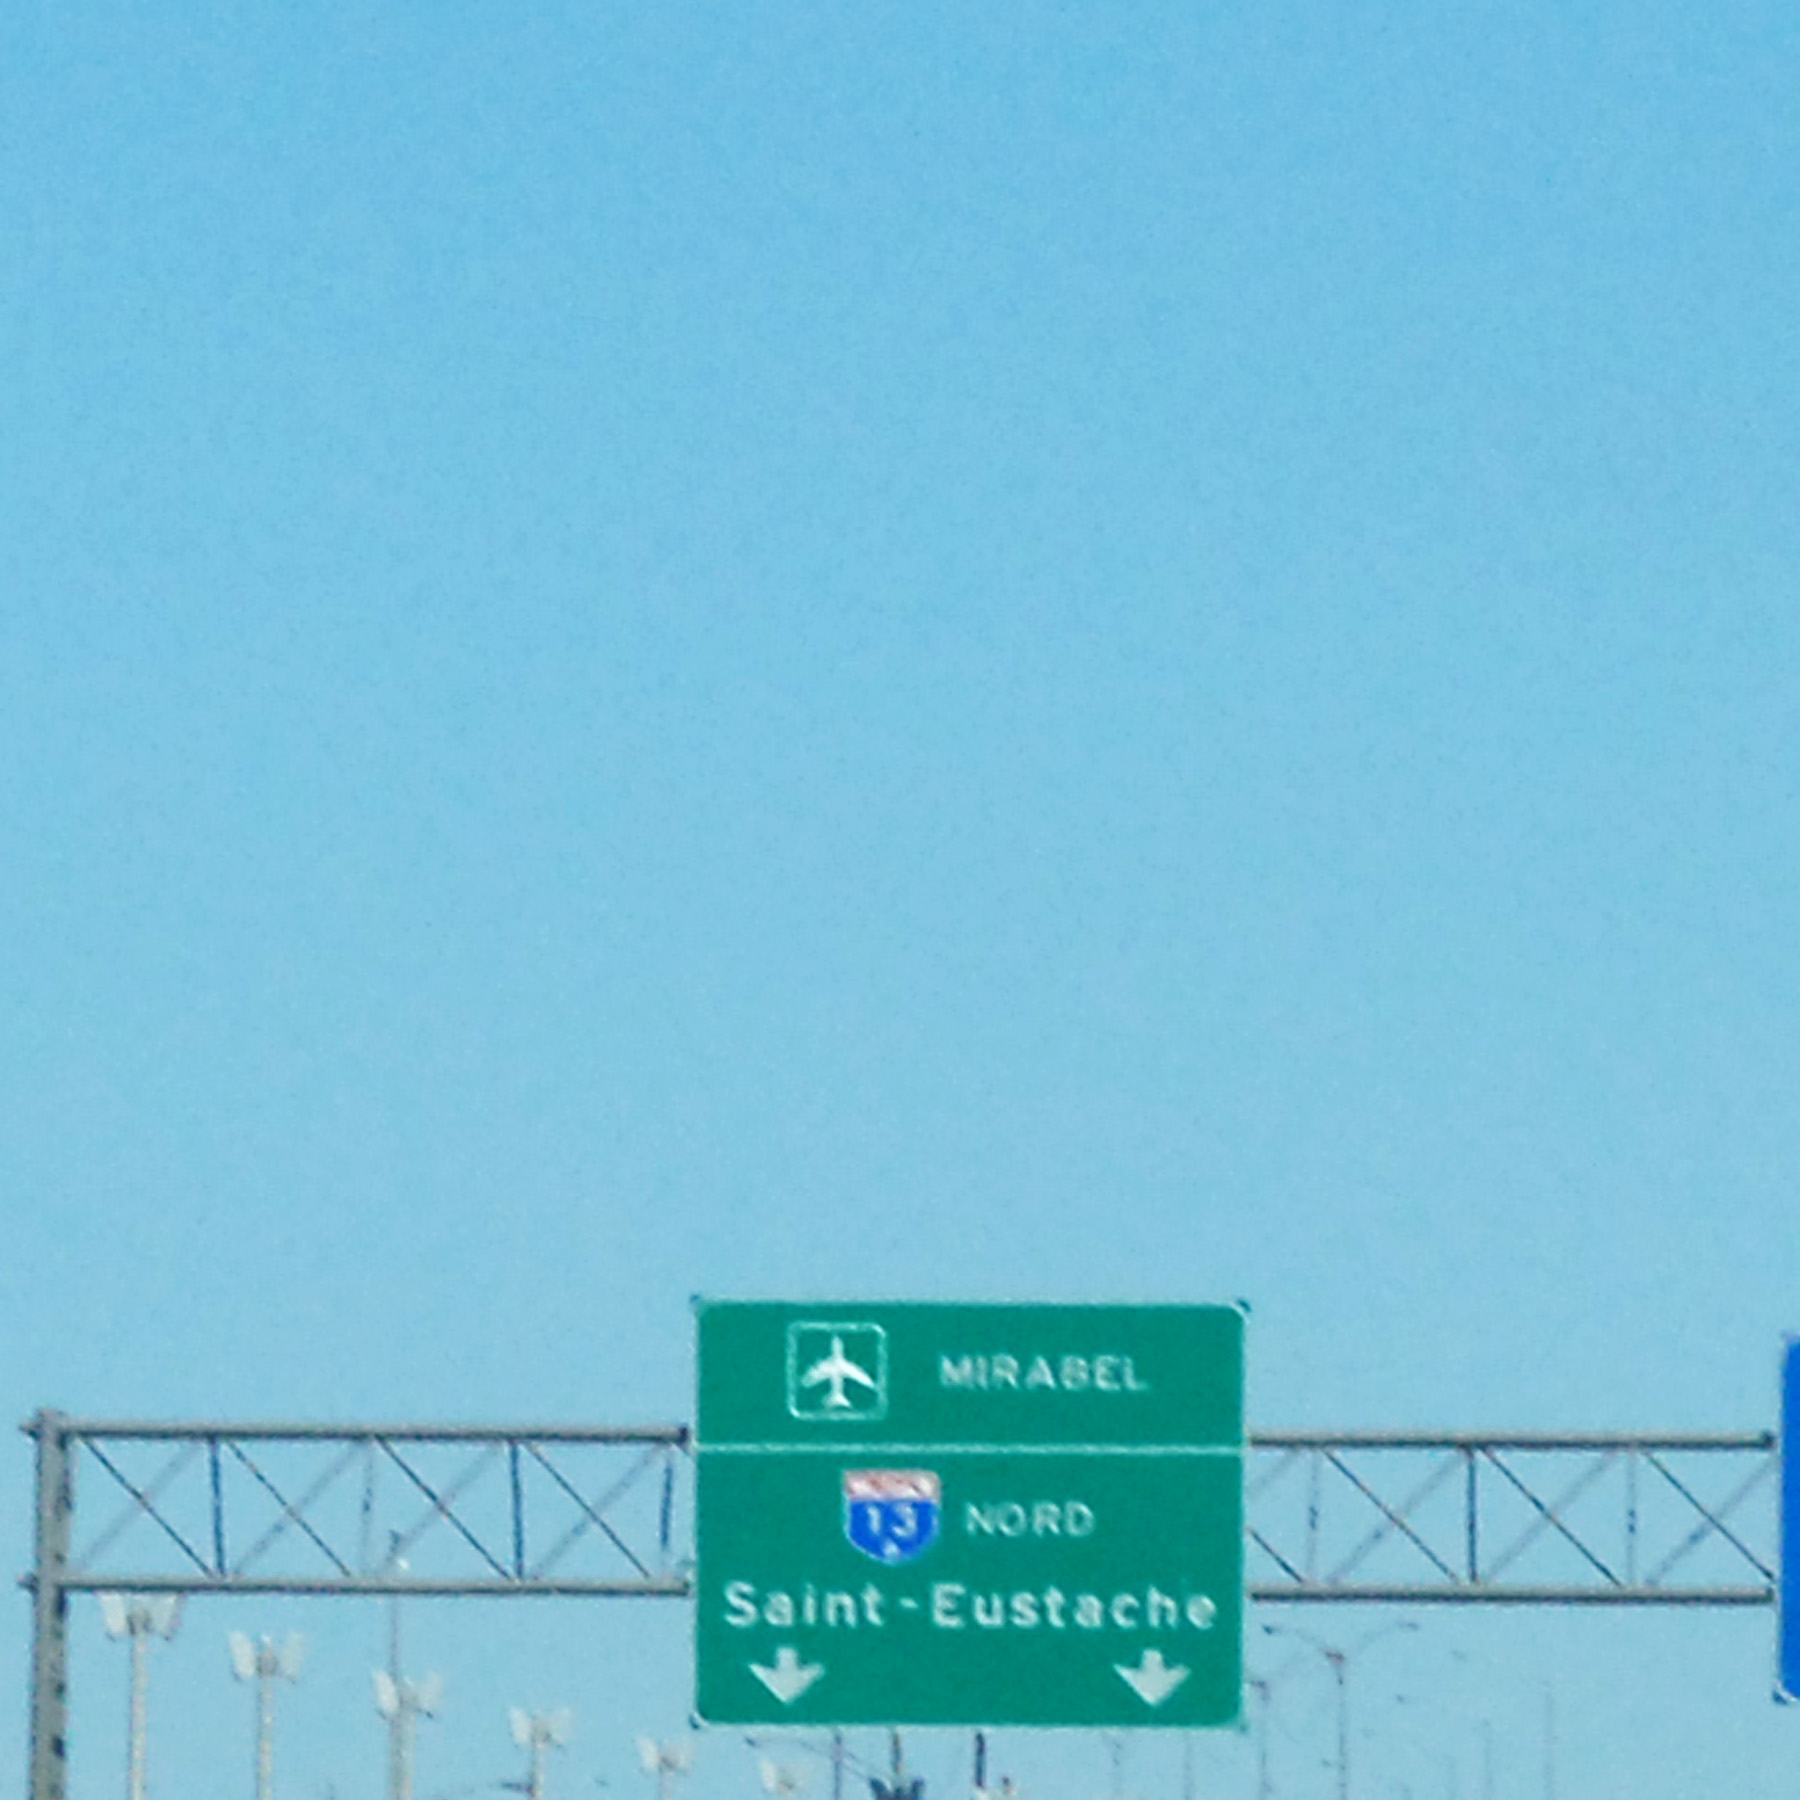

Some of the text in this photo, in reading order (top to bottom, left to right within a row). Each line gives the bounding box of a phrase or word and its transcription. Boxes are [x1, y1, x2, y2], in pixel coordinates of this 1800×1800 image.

[938, 1354, 1147, 1393] MIRABEL
[864, 1504, 918, 1539] 13
[965, 1500, 1096, 1538] NORD
[722, 1580, 1217, 1631] Saint-Eustache
